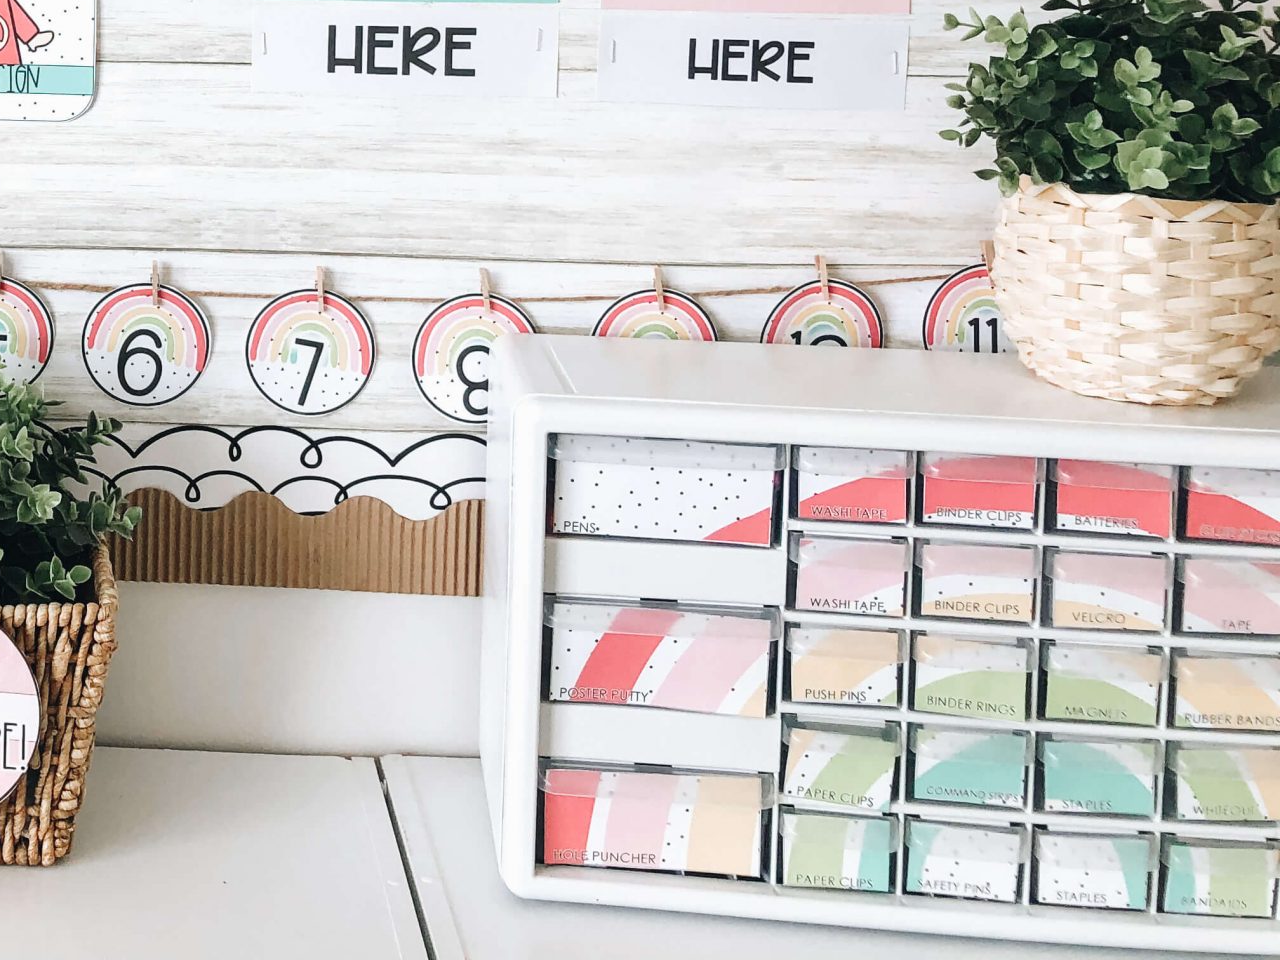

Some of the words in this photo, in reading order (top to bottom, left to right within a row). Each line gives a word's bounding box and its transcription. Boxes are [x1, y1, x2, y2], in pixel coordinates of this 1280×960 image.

[327, 24, 477, 78] HERE
[688, 38, 815, 83] HERE
[118, 328, 163, 396] 6
[294, 337, 324, 406] 7
[810, 505, 853, 518] WASHI
[855, 507, 887, 520] TAPE
[936, 507, 983, 520] BINDER
[986, 510, 1022, 523] CLIPS
[563, 521, 596, 534] PENS
[1075, 515, 1138, 530] BATTERIES
[810, 598, 851, 611] WASHI
[854, 600, 885, 613] TAPE
[935, 600, 981, 613] BINDER
[984, 603, 1019, 616] CLIPS
[1072, 611, 1126, 625] VELCRO
[1222, 619, 1252, 631] TAPE
[559, 687, 607, 700] POSTER
[610, 689, 648, 703] PUTTY
[805, 688, 837, 700] PUSH
[839, 690, 867, 702] PINS
[927, 695, 974, 710] BINDER
[976, 701, 1016, 716] RINGS
[1065, 705, 1127, 719] MAGNETS
[1185, 713, 1232, 725] RUBBER
[796, 785, 836, 801] PAPER
[839, 792, 874, 807] CLIPS
[927, 786, 986, 799] COMMAND
[1062, 799, 1112, 810] STAPLES
[553, 848, 588, 861] HOLE
[592, 850, 656, 864] PUNCHER
[796, 874, 835, 887] PAPER
[839, 876, 873, 889] CLIPS
[918, 879, 960, 893] SAFETY
[963, 882, 992, 895] PINS
[1057, 890, 1107, 903] STAPLES
